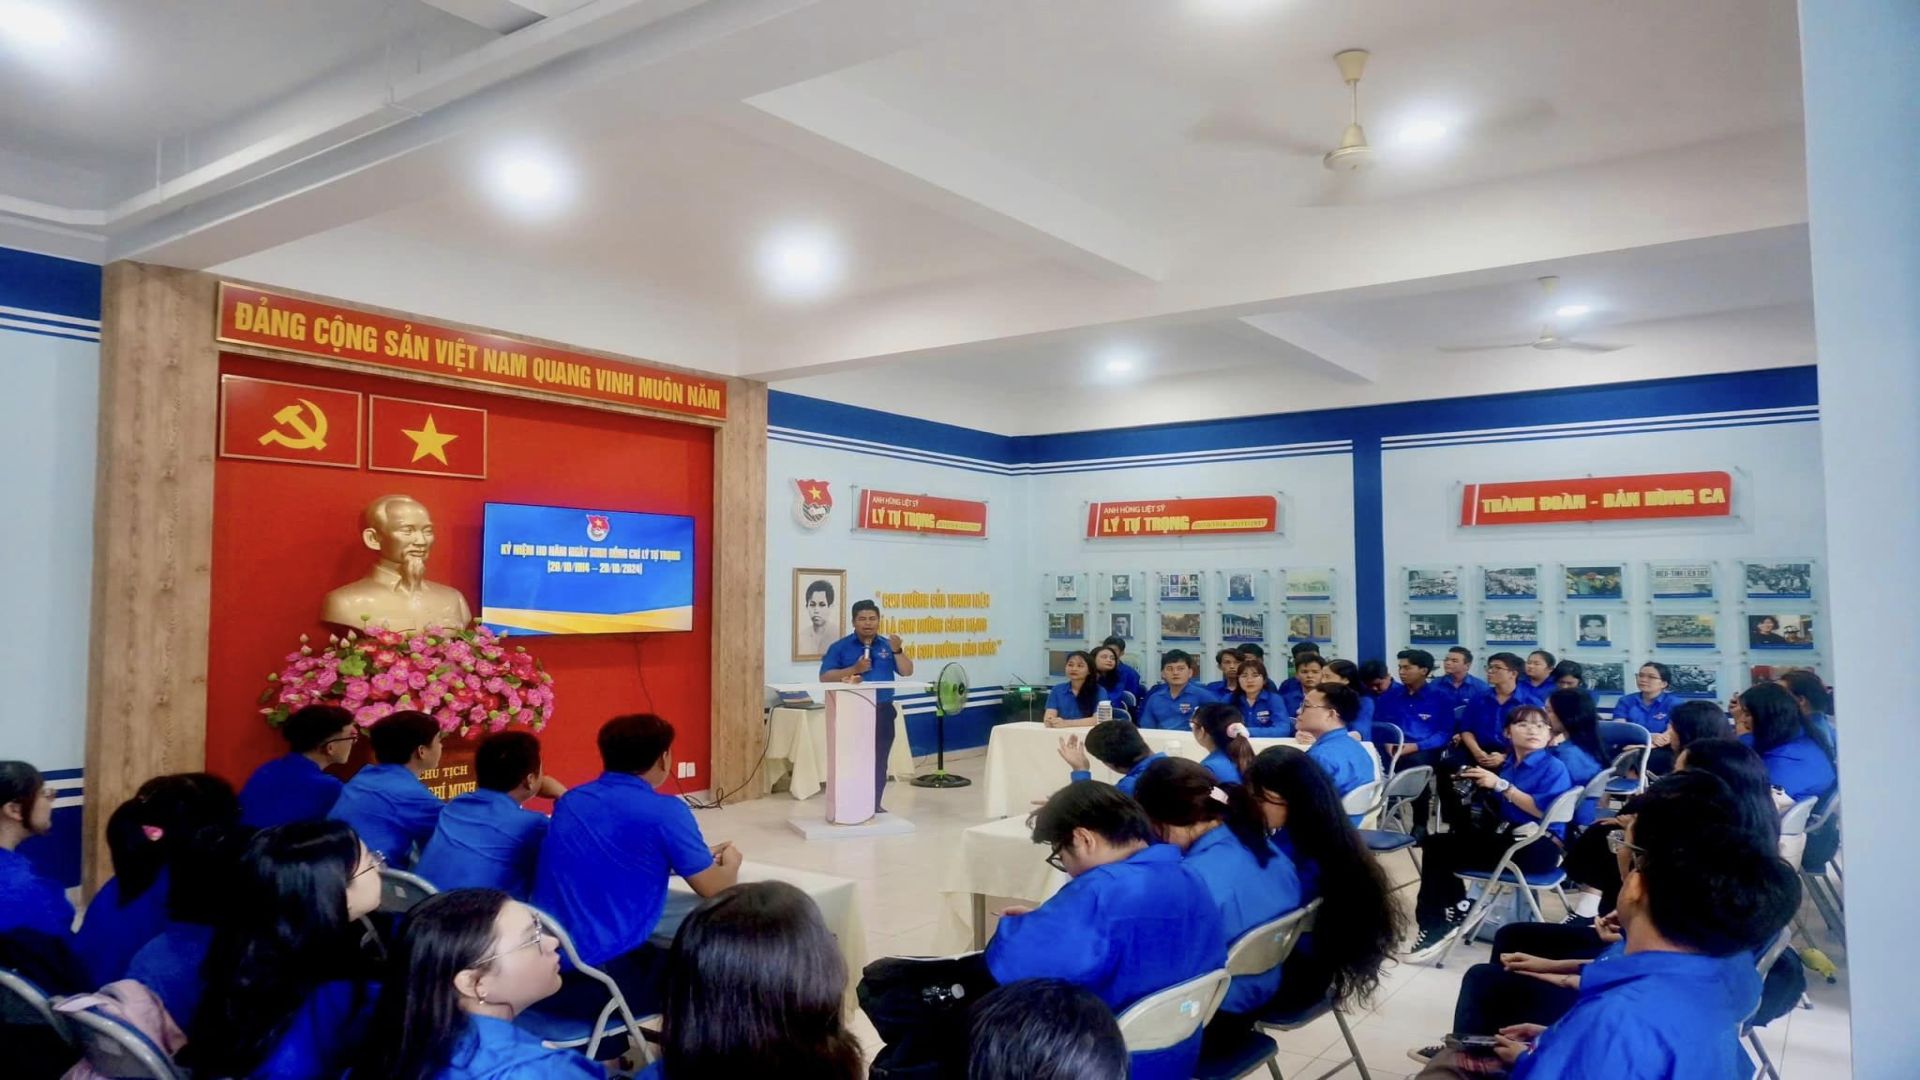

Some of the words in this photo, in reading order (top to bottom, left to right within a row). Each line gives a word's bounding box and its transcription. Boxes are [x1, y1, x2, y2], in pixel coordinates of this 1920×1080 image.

[235, 297, 306, 341] ĐẢNG
[313, 315, 377, 353] CỘNG
[384, 324, 429, 362] SẢN
[436, 337, 479, 373] VIỆT
[483, 348, 527, 378] NAM
[533, 357, 592, 389] QUANG
[596, 368, 634, 396] VINH
[638, 376, 684, 404] MUÔN
[687, 383, 721, 411] NĂM
[1699, 487, 1726, 504] CA
[872, 507, 885, 524] LÝ
[887, 509, 901, 528] TỰ
[1103, 506, 1119, 514] ANH
[1103, 516, 1120, 533] LÝ
[1123, 516, 1141, 534] TỰ
[1143, 515, 1190, 533] TRỌNG
[442, 765, 468, 779] TỊCH
[448, 781, 477, 799] MINH
